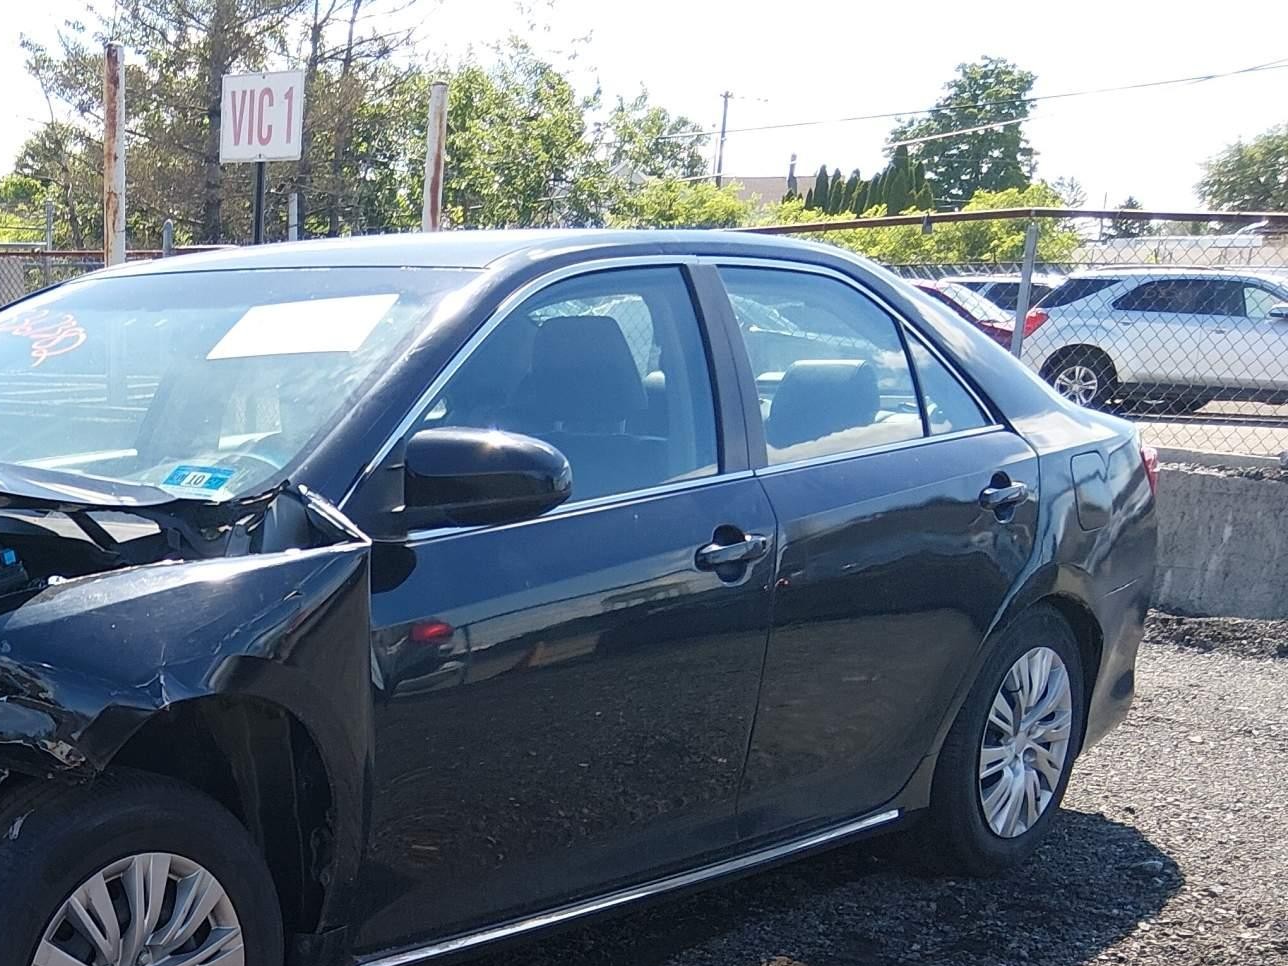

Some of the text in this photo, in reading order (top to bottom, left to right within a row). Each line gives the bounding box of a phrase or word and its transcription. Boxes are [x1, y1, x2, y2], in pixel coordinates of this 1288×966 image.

[230, 86, 294, 146] VIC 1
[188, 475, 205, 486] 10
